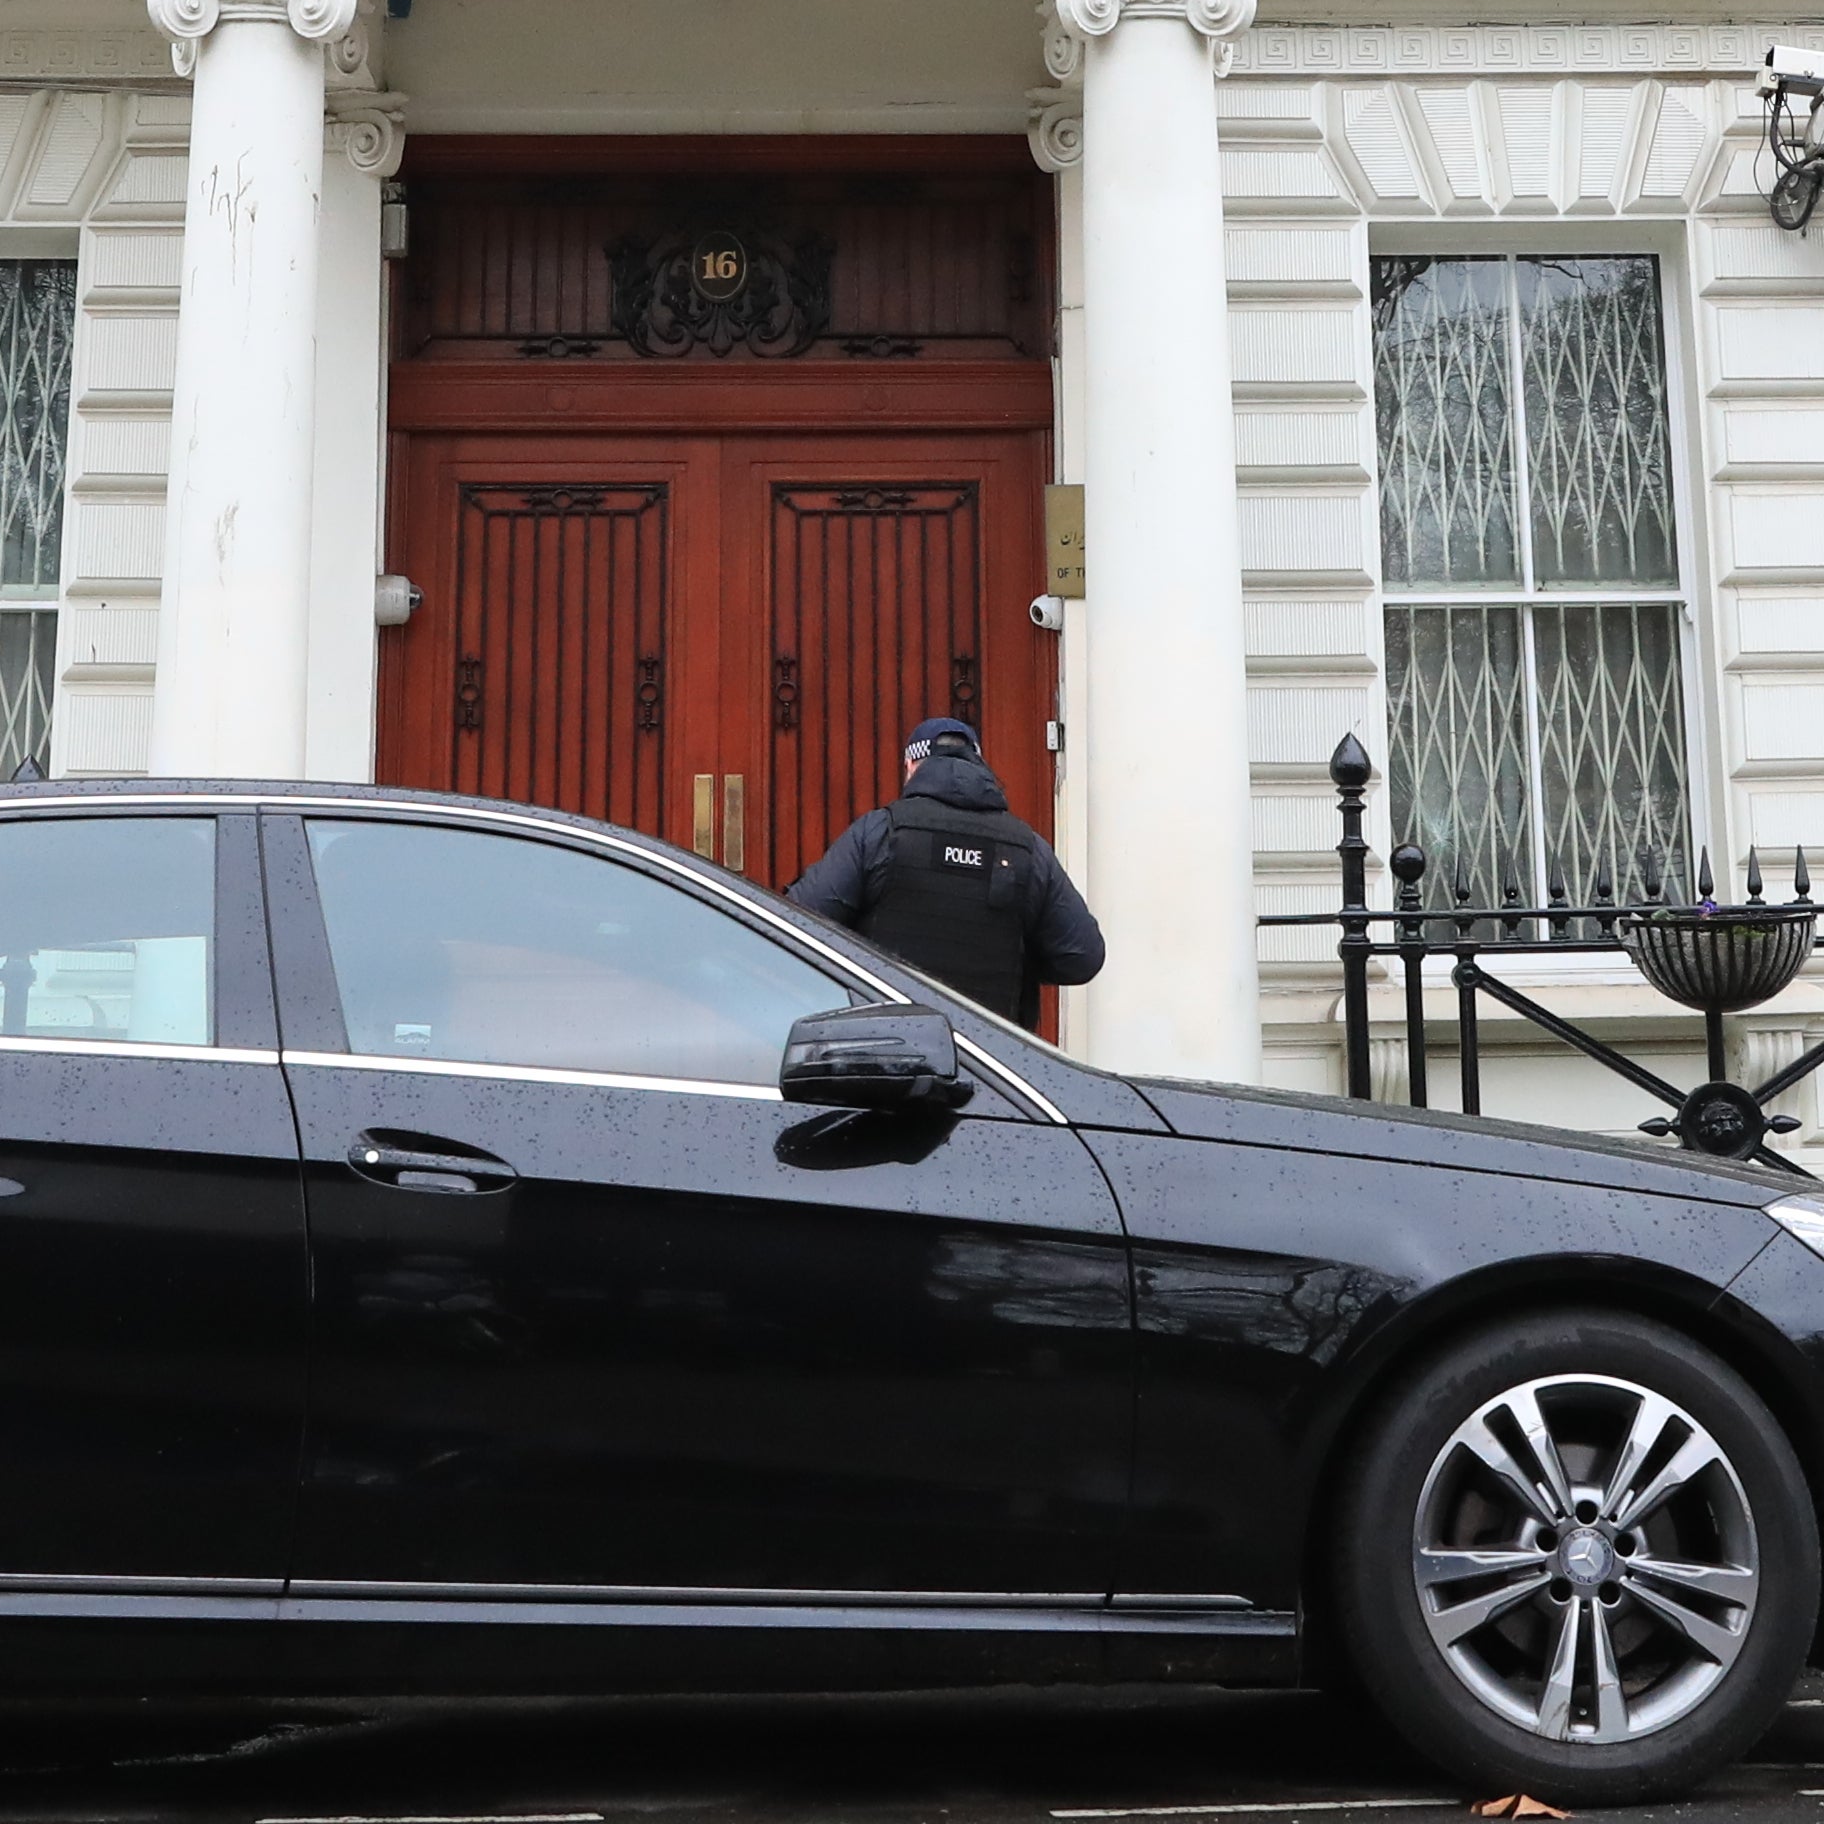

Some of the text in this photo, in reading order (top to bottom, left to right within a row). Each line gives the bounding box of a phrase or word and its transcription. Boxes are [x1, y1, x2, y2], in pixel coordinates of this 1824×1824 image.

[701, 251, 737, 279] 16
[1057, 567, 1070, 579] OF
[945, 846, 982, 866] POLICE
